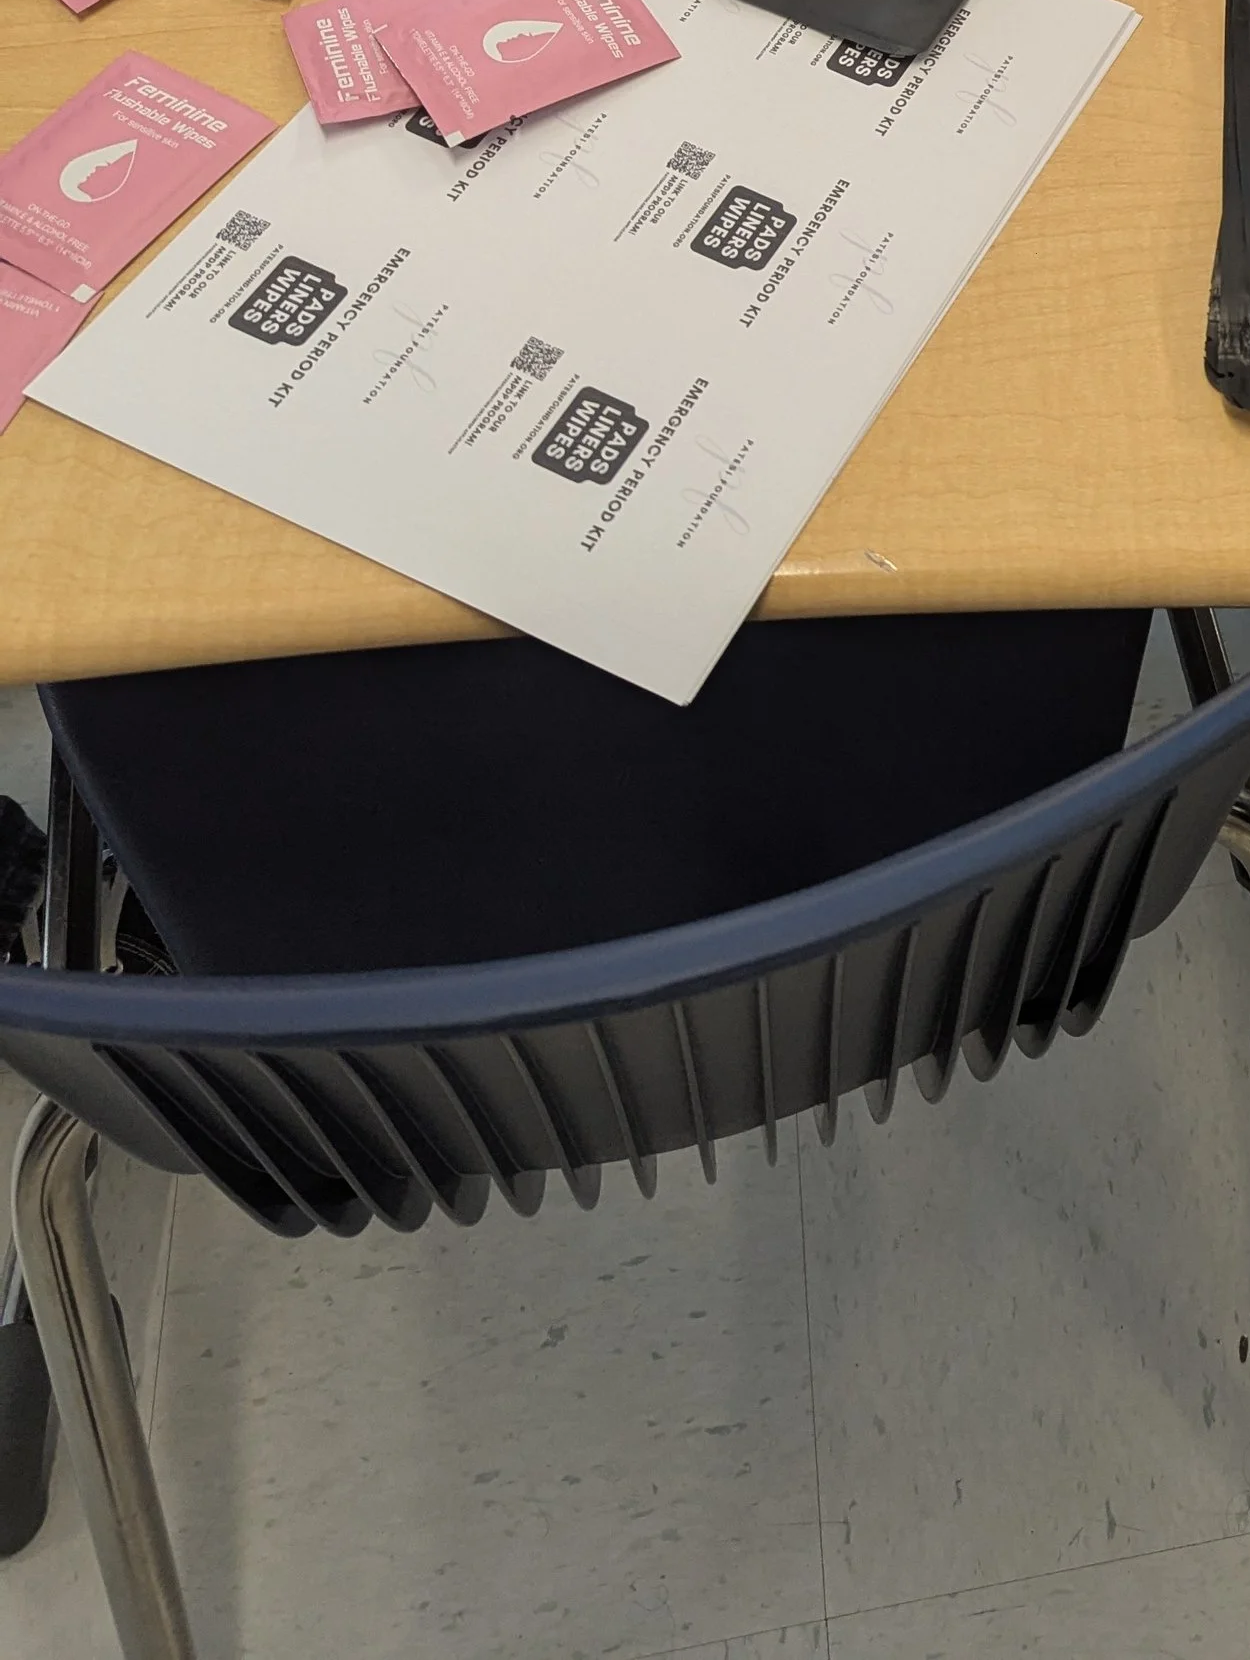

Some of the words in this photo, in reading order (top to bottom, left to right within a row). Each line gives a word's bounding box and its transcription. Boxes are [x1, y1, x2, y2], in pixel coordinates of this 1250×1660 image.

[338, 7, 359, 42] Wipes
[562, 7, 585, 35] sensitive
[581, 31, 594, 45] skin
[595, 22, 624, 59] Wipes
[923, 8, 971, 75] EMERGENCY
[317, 18, 360, 103] Feminine
[351, 43, 381, 102] Flushable
[992, 54, 1014, 84] PATESI
[124, 76, 228, 134] Feminine
[889, 75, 925, 115] PERIOD
[955, 83, 995, 135] FOUNDATION
[103, 88, 170, 125] Flushable
[171, 122, 216, 149] Wipes
[112, 110, 127, 123] For
[127, 117, 163, 141] sensitive
[161, 133, 180, 149] skin
[580, 112, 608, 144] PATESI
[875, 116, 895, 137] KIT
[466, 136, 508, 180] PERIOD
[533, 144, 583, 200] FOUNDATION
[446, 179, 470, 202] KIT
[656, 174, 679, 203] MPDP
[663, 197, 676, 209] TO
[672, 178, 688, 198] LINK
[628, 203, 662, 237] PROGRAM!
[649, 207, 666, 225] OUR
[703, 195, 751, 249] WIPES
[721, 202, 771, 260] LINERS
[791, 178, 850, 257] EMERGENCY
[202, 245, 226, 274] MPDP
[217, 250, 236, 269] LINK
[744, 215, 786, 263] PADS
[868, 231, 894, 265] PATESI
[164, 273, 206, 312] PROGRAM!
[188, 280, 208, 300] OUR
[206, 269, 220, 284] TO
[243, 267, 301, 323] WIPES
[336, 247, 411, 332] EMERGENCY
[756, 256, 795, 304] PERIOD
[827, 264, 871, 326] FOUNDATION
[260, 272, 322, 335] LINERS
[285, 287, 336, 337] PADS
[418, 303, 449, 339] PATESI
[739, 304, 761, 329] KIT
[290, 332, 339, 381] PERIOD
[362, 340, 419, 405] FOUNDATION
[267, 382, 293, 408] KIT
[498, 375, 522, 406] MPDP
[503, 400, 517, 414] TO
[514, 380, 533, 400] LINK
[465, 406, 502, 448] PROGRAM!
[488, 411, 506, 433] OUR
[545, 399, 600, 461] WIPES
[564, 405, 622, 472] LINERS
[640, 376, 709, 468] EMERGENCY
[590, 419, 637, 475] PADS
[722, 437, 754, 480] PATESI
[600, 468, 645, 523] PERIOD
[676, 478, 727, 549] FOUNDATION
[580, 525, 606, 552] KIT
